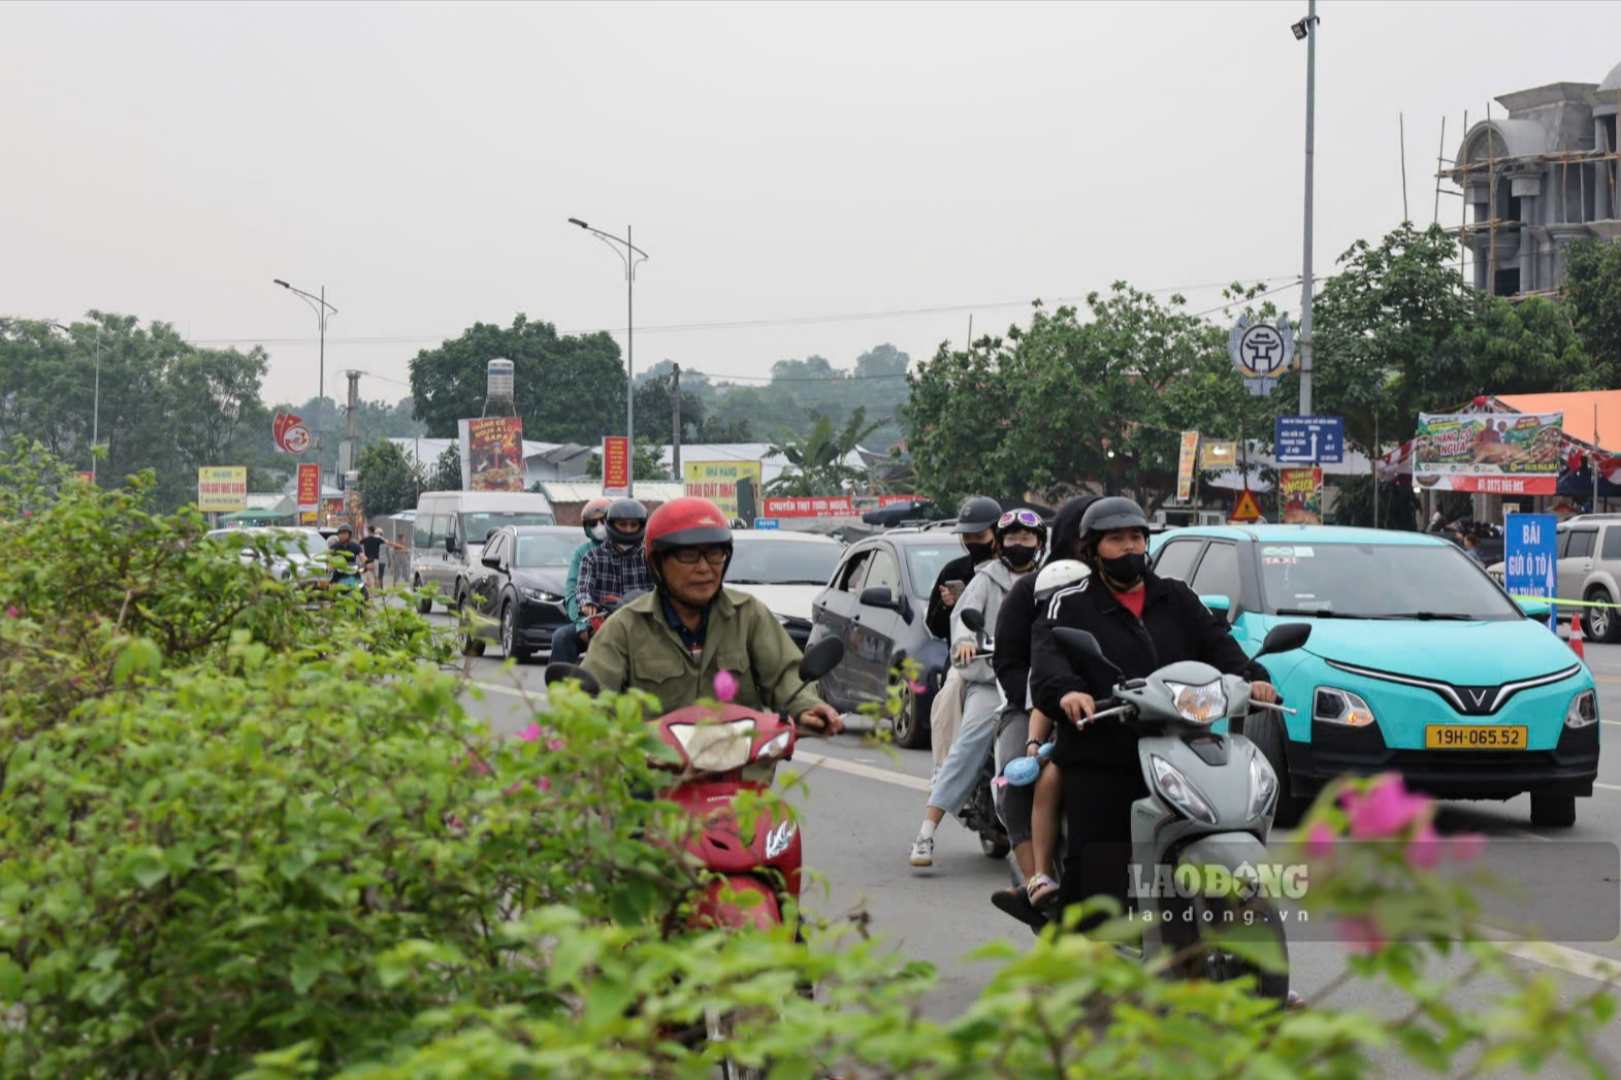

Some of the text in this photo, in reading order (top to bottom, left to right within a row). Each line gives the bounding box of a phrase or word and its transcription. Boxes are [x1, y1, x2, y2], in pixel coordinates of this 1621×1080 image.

[1523, 521, 1540, 545] BÃI
[1508, 549, 1546, 577] GỬI Ô TÔ
